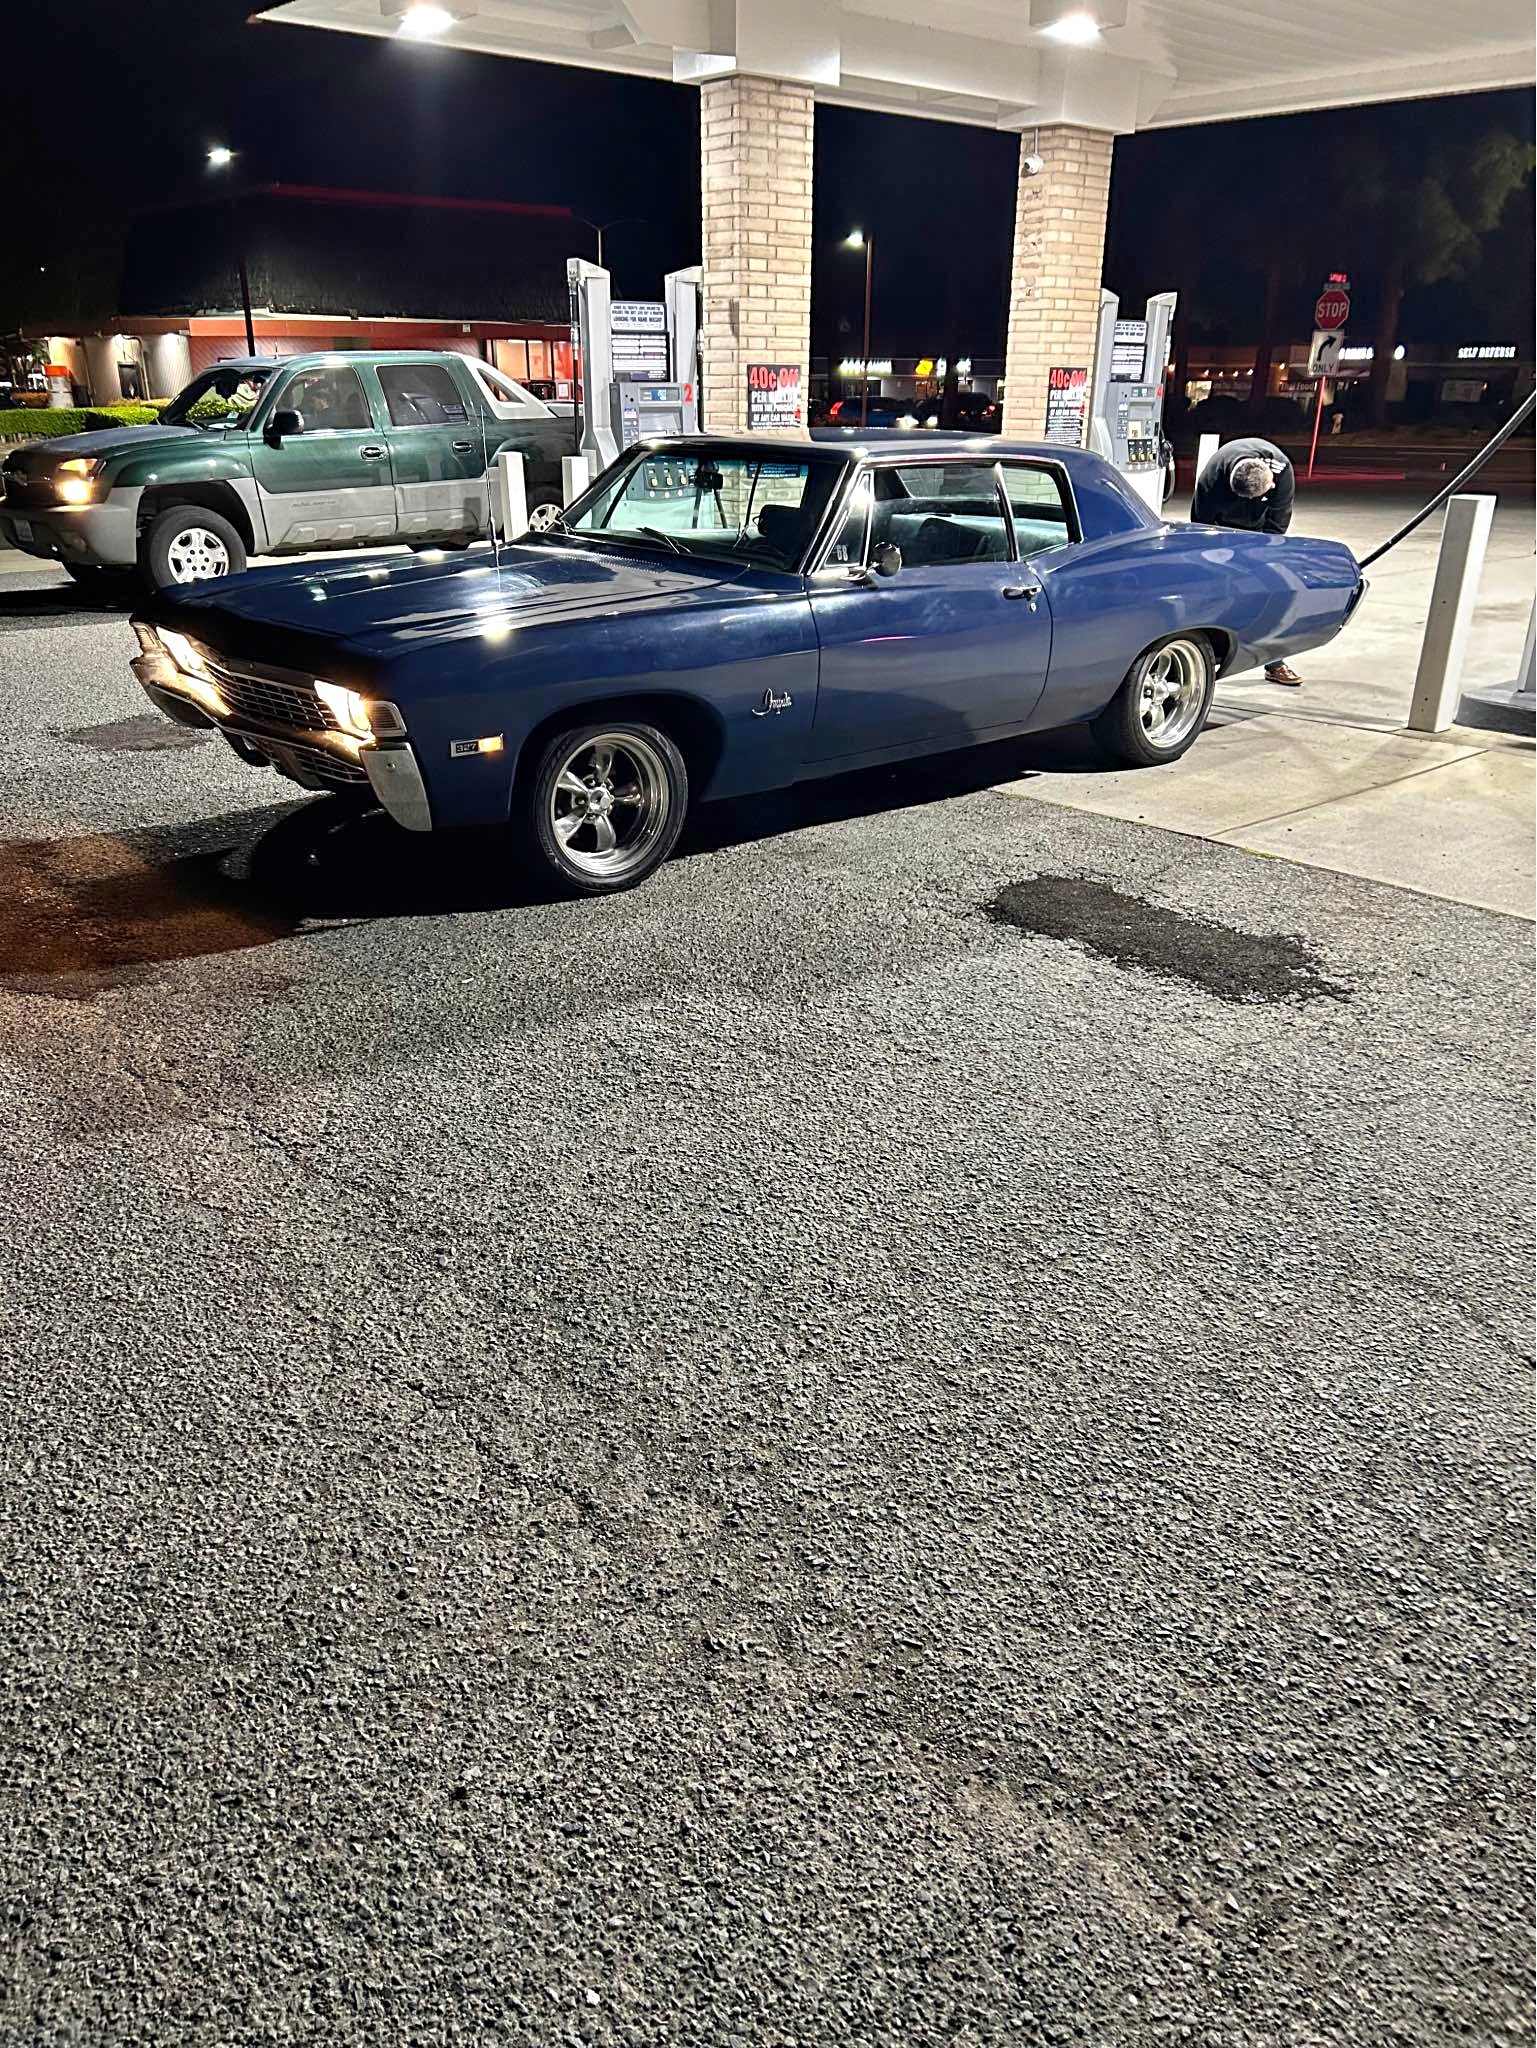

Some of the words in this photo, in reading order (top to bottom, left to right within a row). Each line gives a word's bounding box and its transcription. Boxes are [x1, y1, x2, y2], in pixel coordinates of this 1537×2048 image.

[1318, 302, 1347, 318] STOP
[1457, 347, 1477, 359] SELF
[1478, 346, 1515, 359] DEFENSE
[1312, 362, 1334, 373] ONLY
[684, 384, 693, 401] 2
[752, 391, 767, 403] PER
[836, 544, 848, 561] 68
